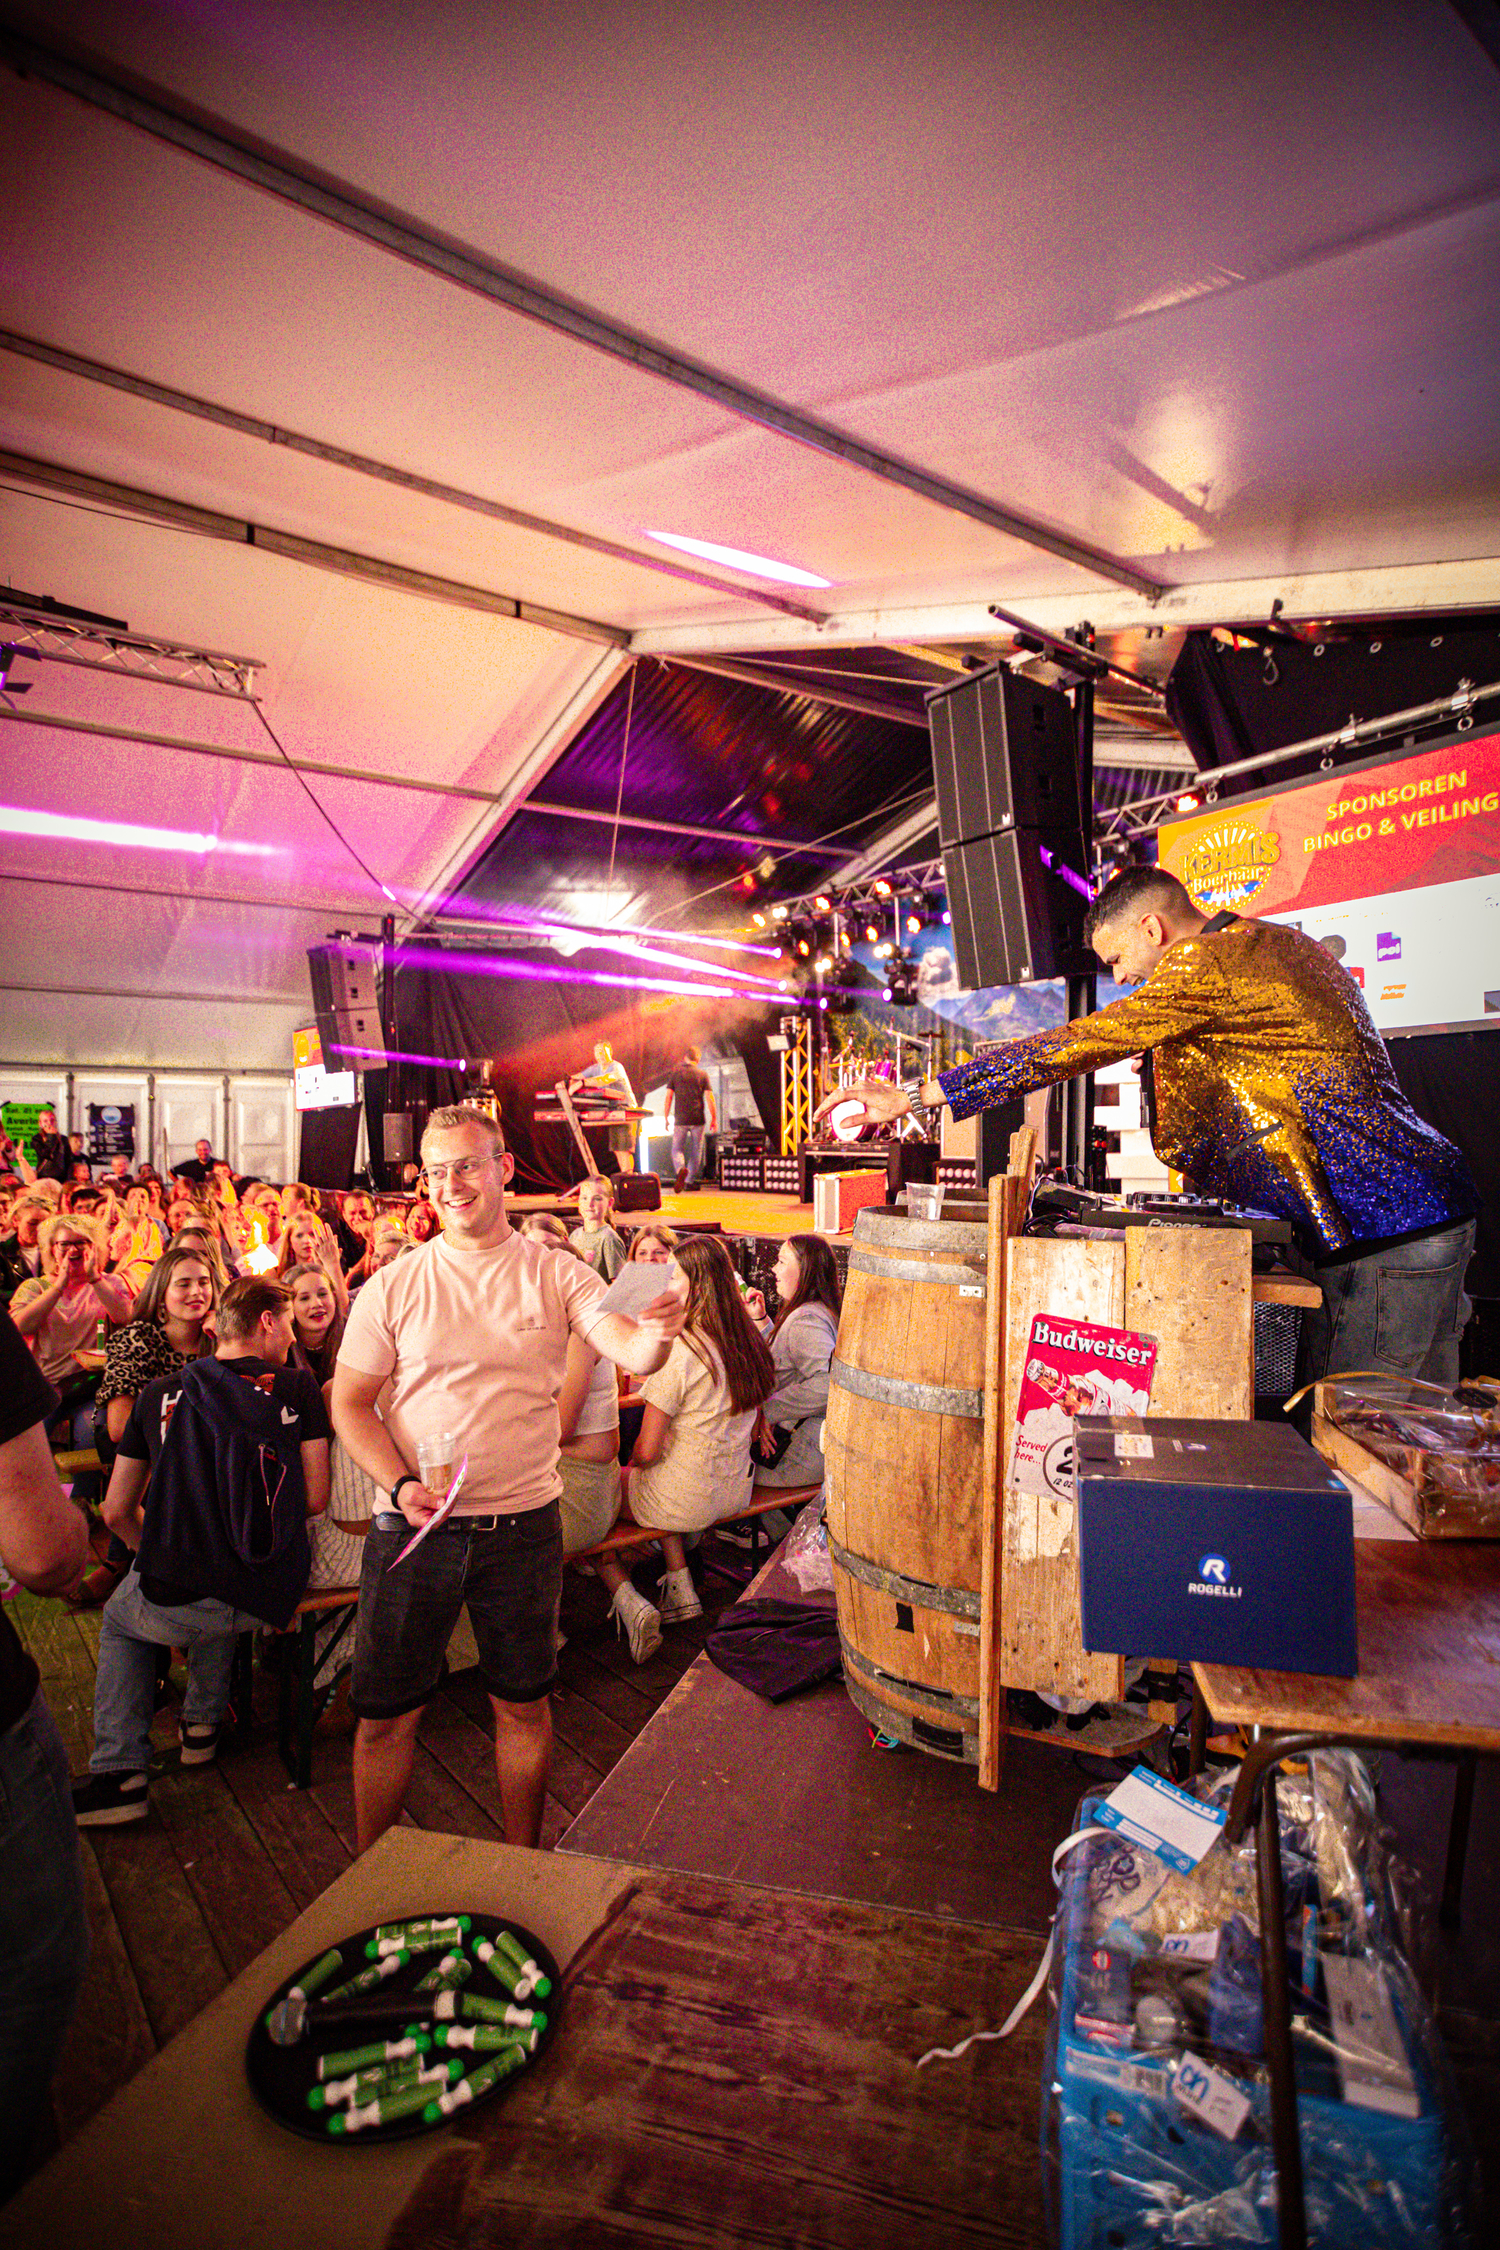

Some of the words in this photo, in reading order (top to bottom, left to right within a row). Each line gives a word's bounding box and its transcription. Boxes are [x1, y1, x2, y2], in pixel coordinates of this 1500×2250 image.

[1326, 769, 1467, 821] SPONSOREN
[1303, 822, 1373, 854] BINGO
[1378, 817, 1396, 836] &
[1401, 792, 1499, 830] VEILING
[1179, 832, 1280, 884] KERMIS
[1193, 866, 1264, 894] Boerhaar
[1032, 1321, 1152, 1366] Budweiser
[1014, 1447, 1041, 1465] here...
[1015, 1434, 1048, 1453] Served
[1188, 1582, 1243, 1599] ROGELLI
